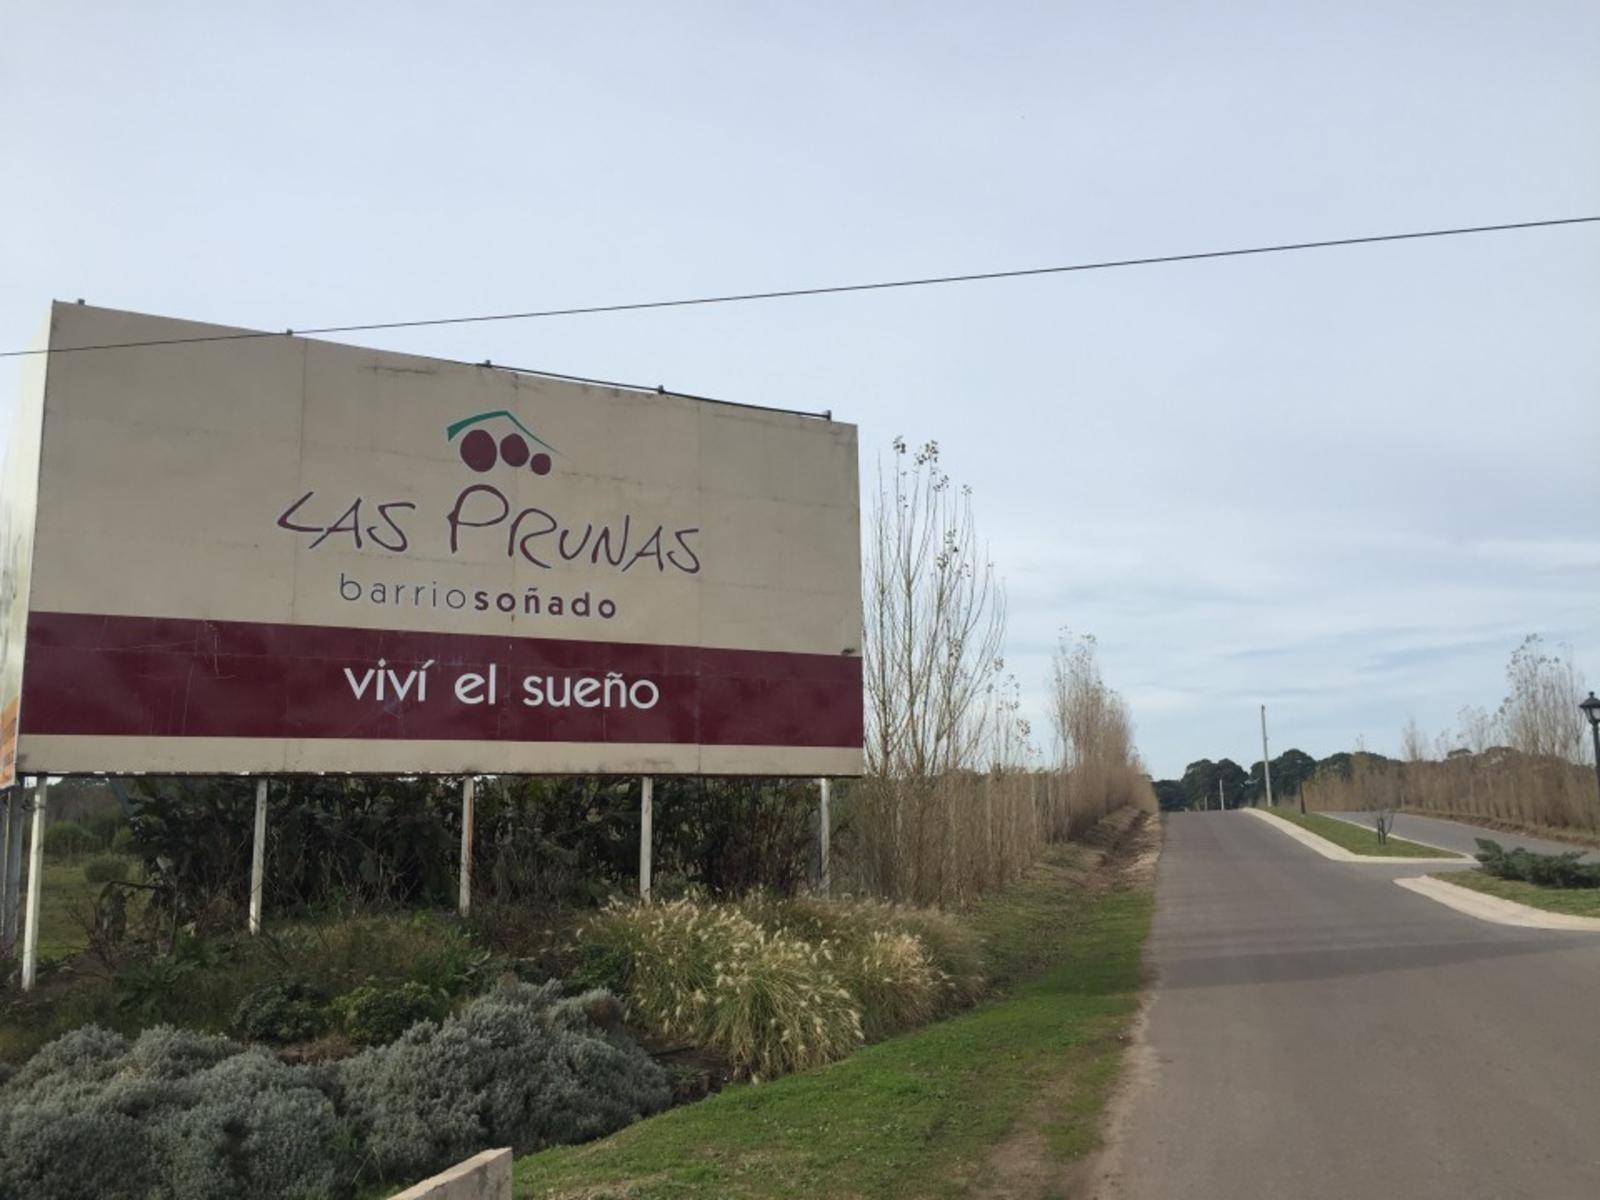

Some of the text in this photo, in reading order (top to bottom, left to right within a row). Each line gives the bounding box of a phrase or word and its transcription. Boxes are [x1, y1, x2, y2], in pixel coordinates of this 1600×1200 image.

[277, 484, 701, 573] LAS PRUNAS
[343, 658, 660, 709] viví el sueño
